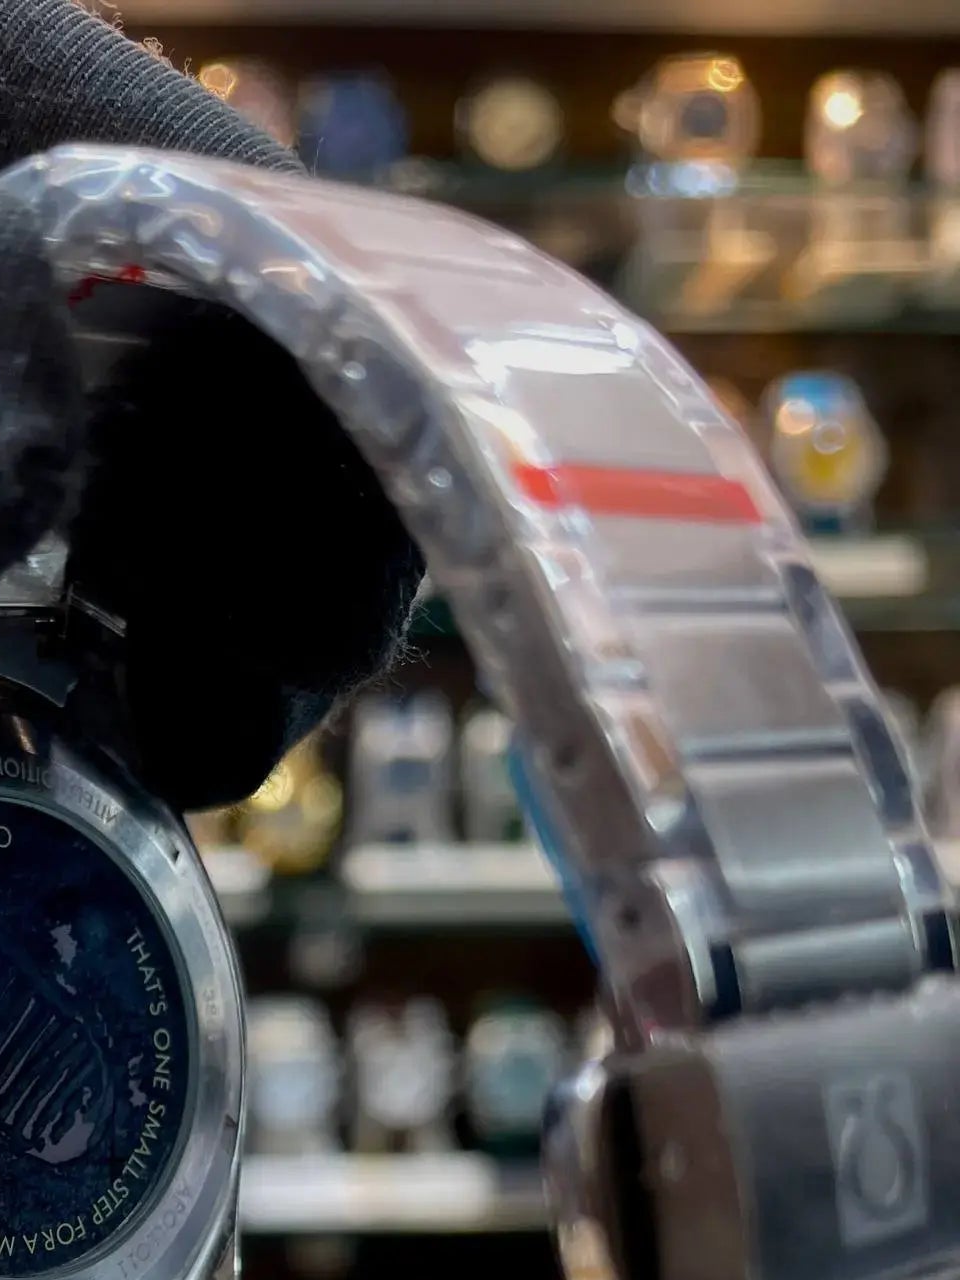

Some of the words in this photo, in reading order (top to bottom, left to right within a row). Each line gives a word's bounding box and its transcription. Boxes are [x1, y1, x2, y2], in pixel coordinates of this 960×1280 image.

[126, 927, 168, 1016] THAT'S
[152, 1028, 171, 1090] ONE
[122, 1100, 166, 1179] SMALL
[92, 1178, 130, 1225] STEP
[22, 1232, 39, 1255] A
[41, 1215, 87, 1251] FOR
